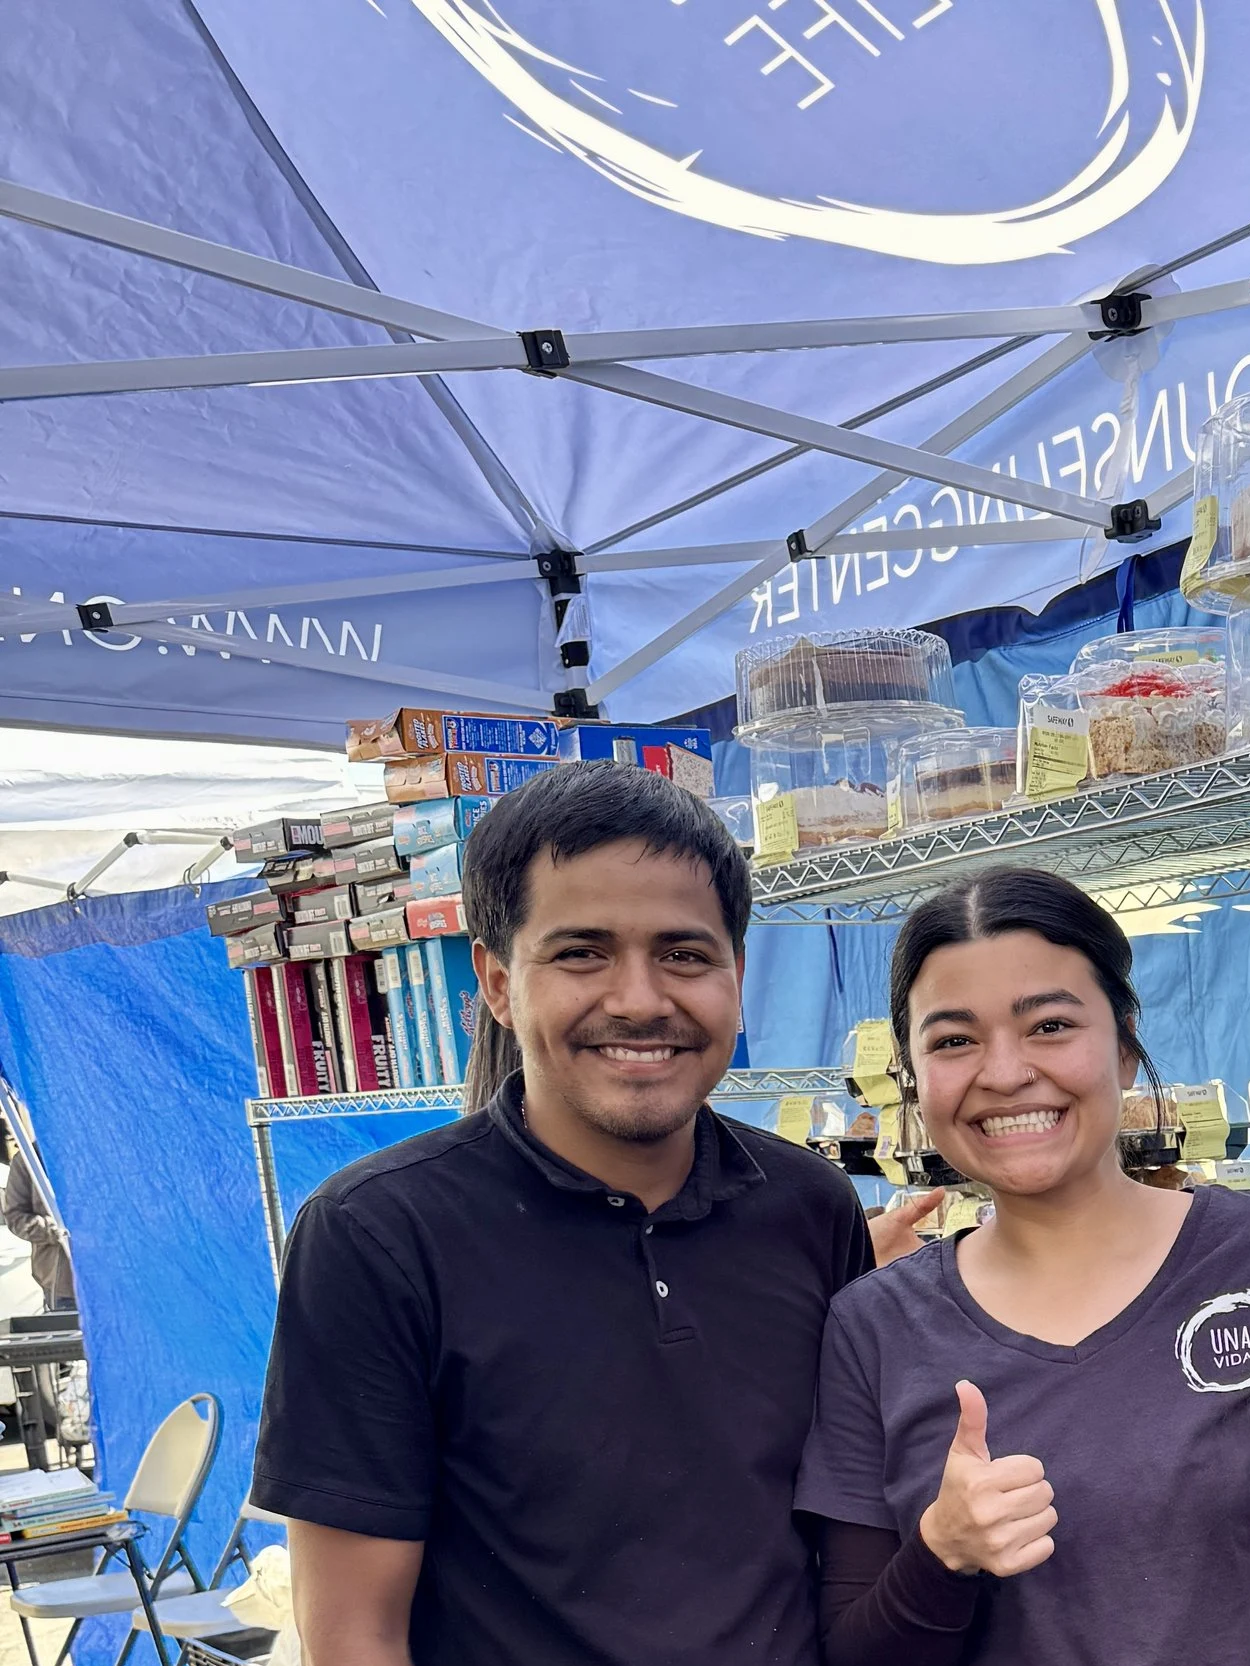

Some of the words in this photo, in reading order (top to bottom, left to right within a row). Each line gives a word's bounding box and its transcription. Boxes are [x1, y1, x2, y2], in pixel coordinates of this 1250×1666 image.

[459, 990, 474, 1037] Kellogg's
[312, 1040, 332, 1094] FRUITY
[371, 1034, 393, 1089] FRUITY
